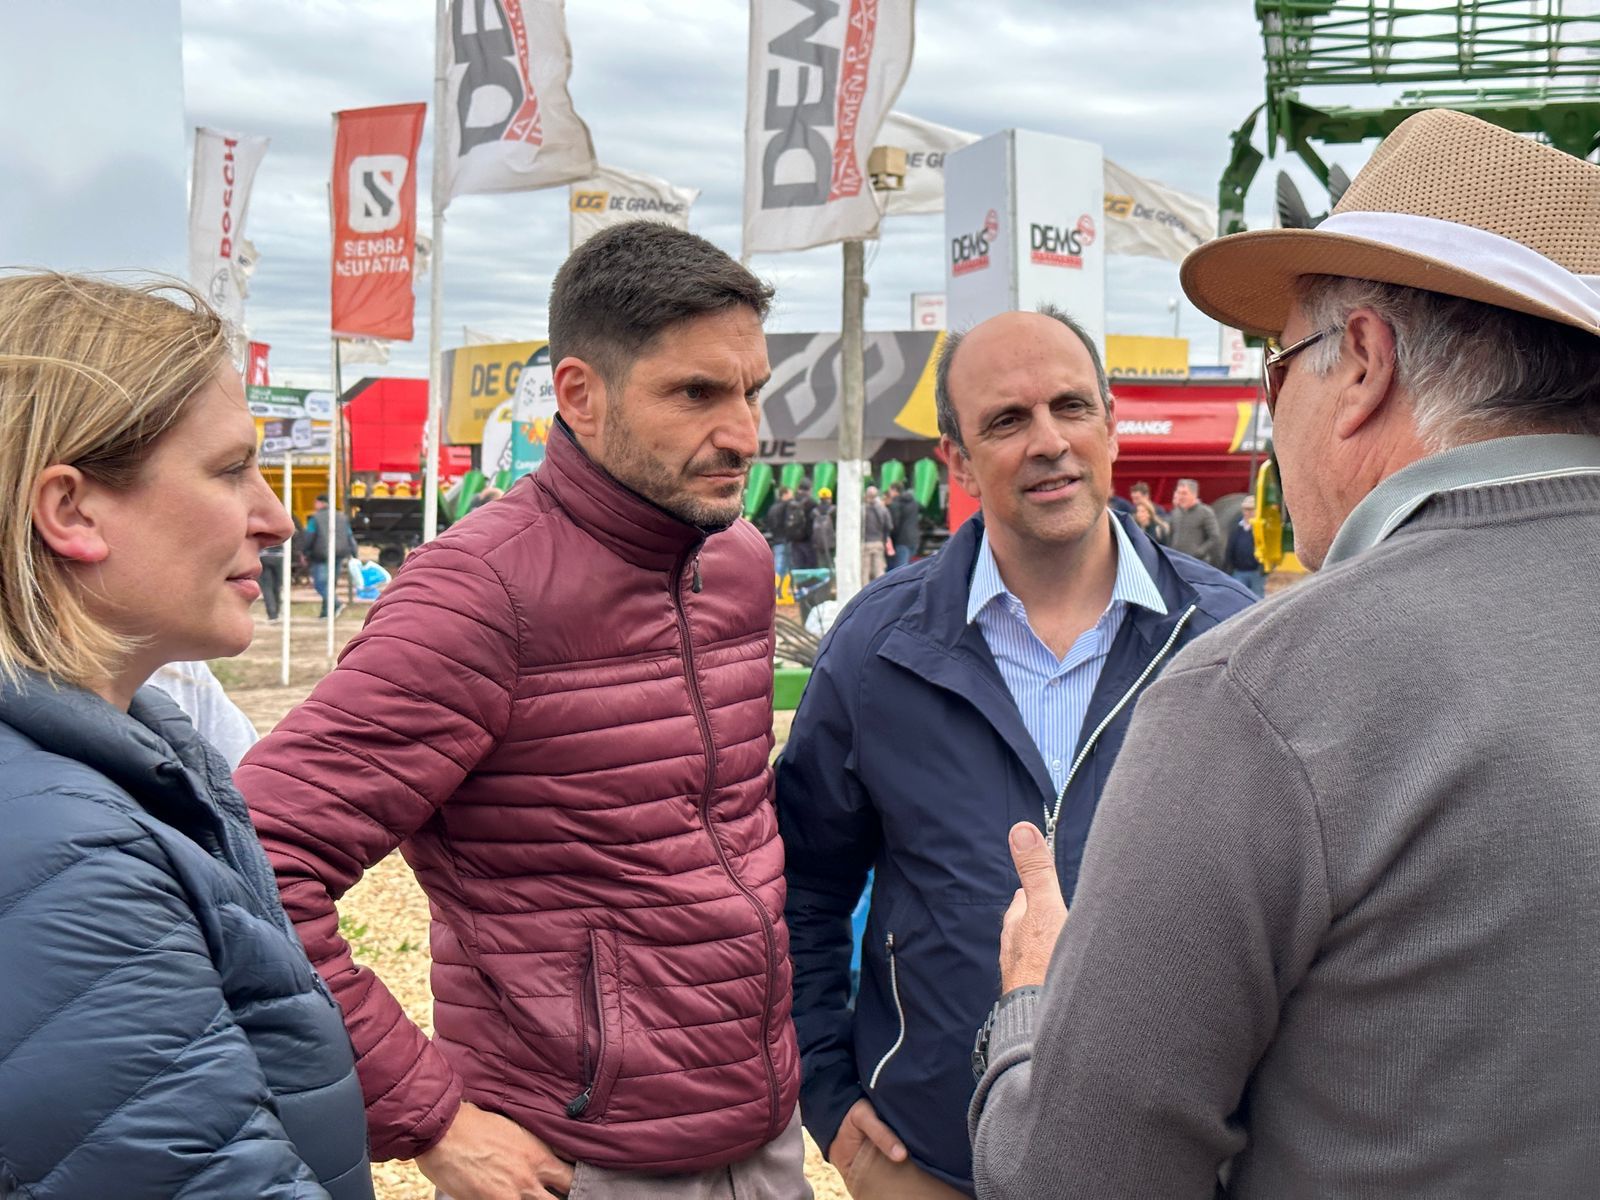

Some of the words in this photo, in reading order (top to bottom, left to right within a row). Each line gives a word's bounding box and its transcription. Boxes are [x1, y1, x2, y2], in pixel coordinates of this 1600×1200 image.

[609, 196, 624, 211] DE
[1132, 203, 1154, 220] DE
[952, 228, 989, 263] DEMS
[1031, 223, 1082, 255] DEMS
[470, 363, 502, 397] DE
[1116, 420, 1173, 435] GRANDE
